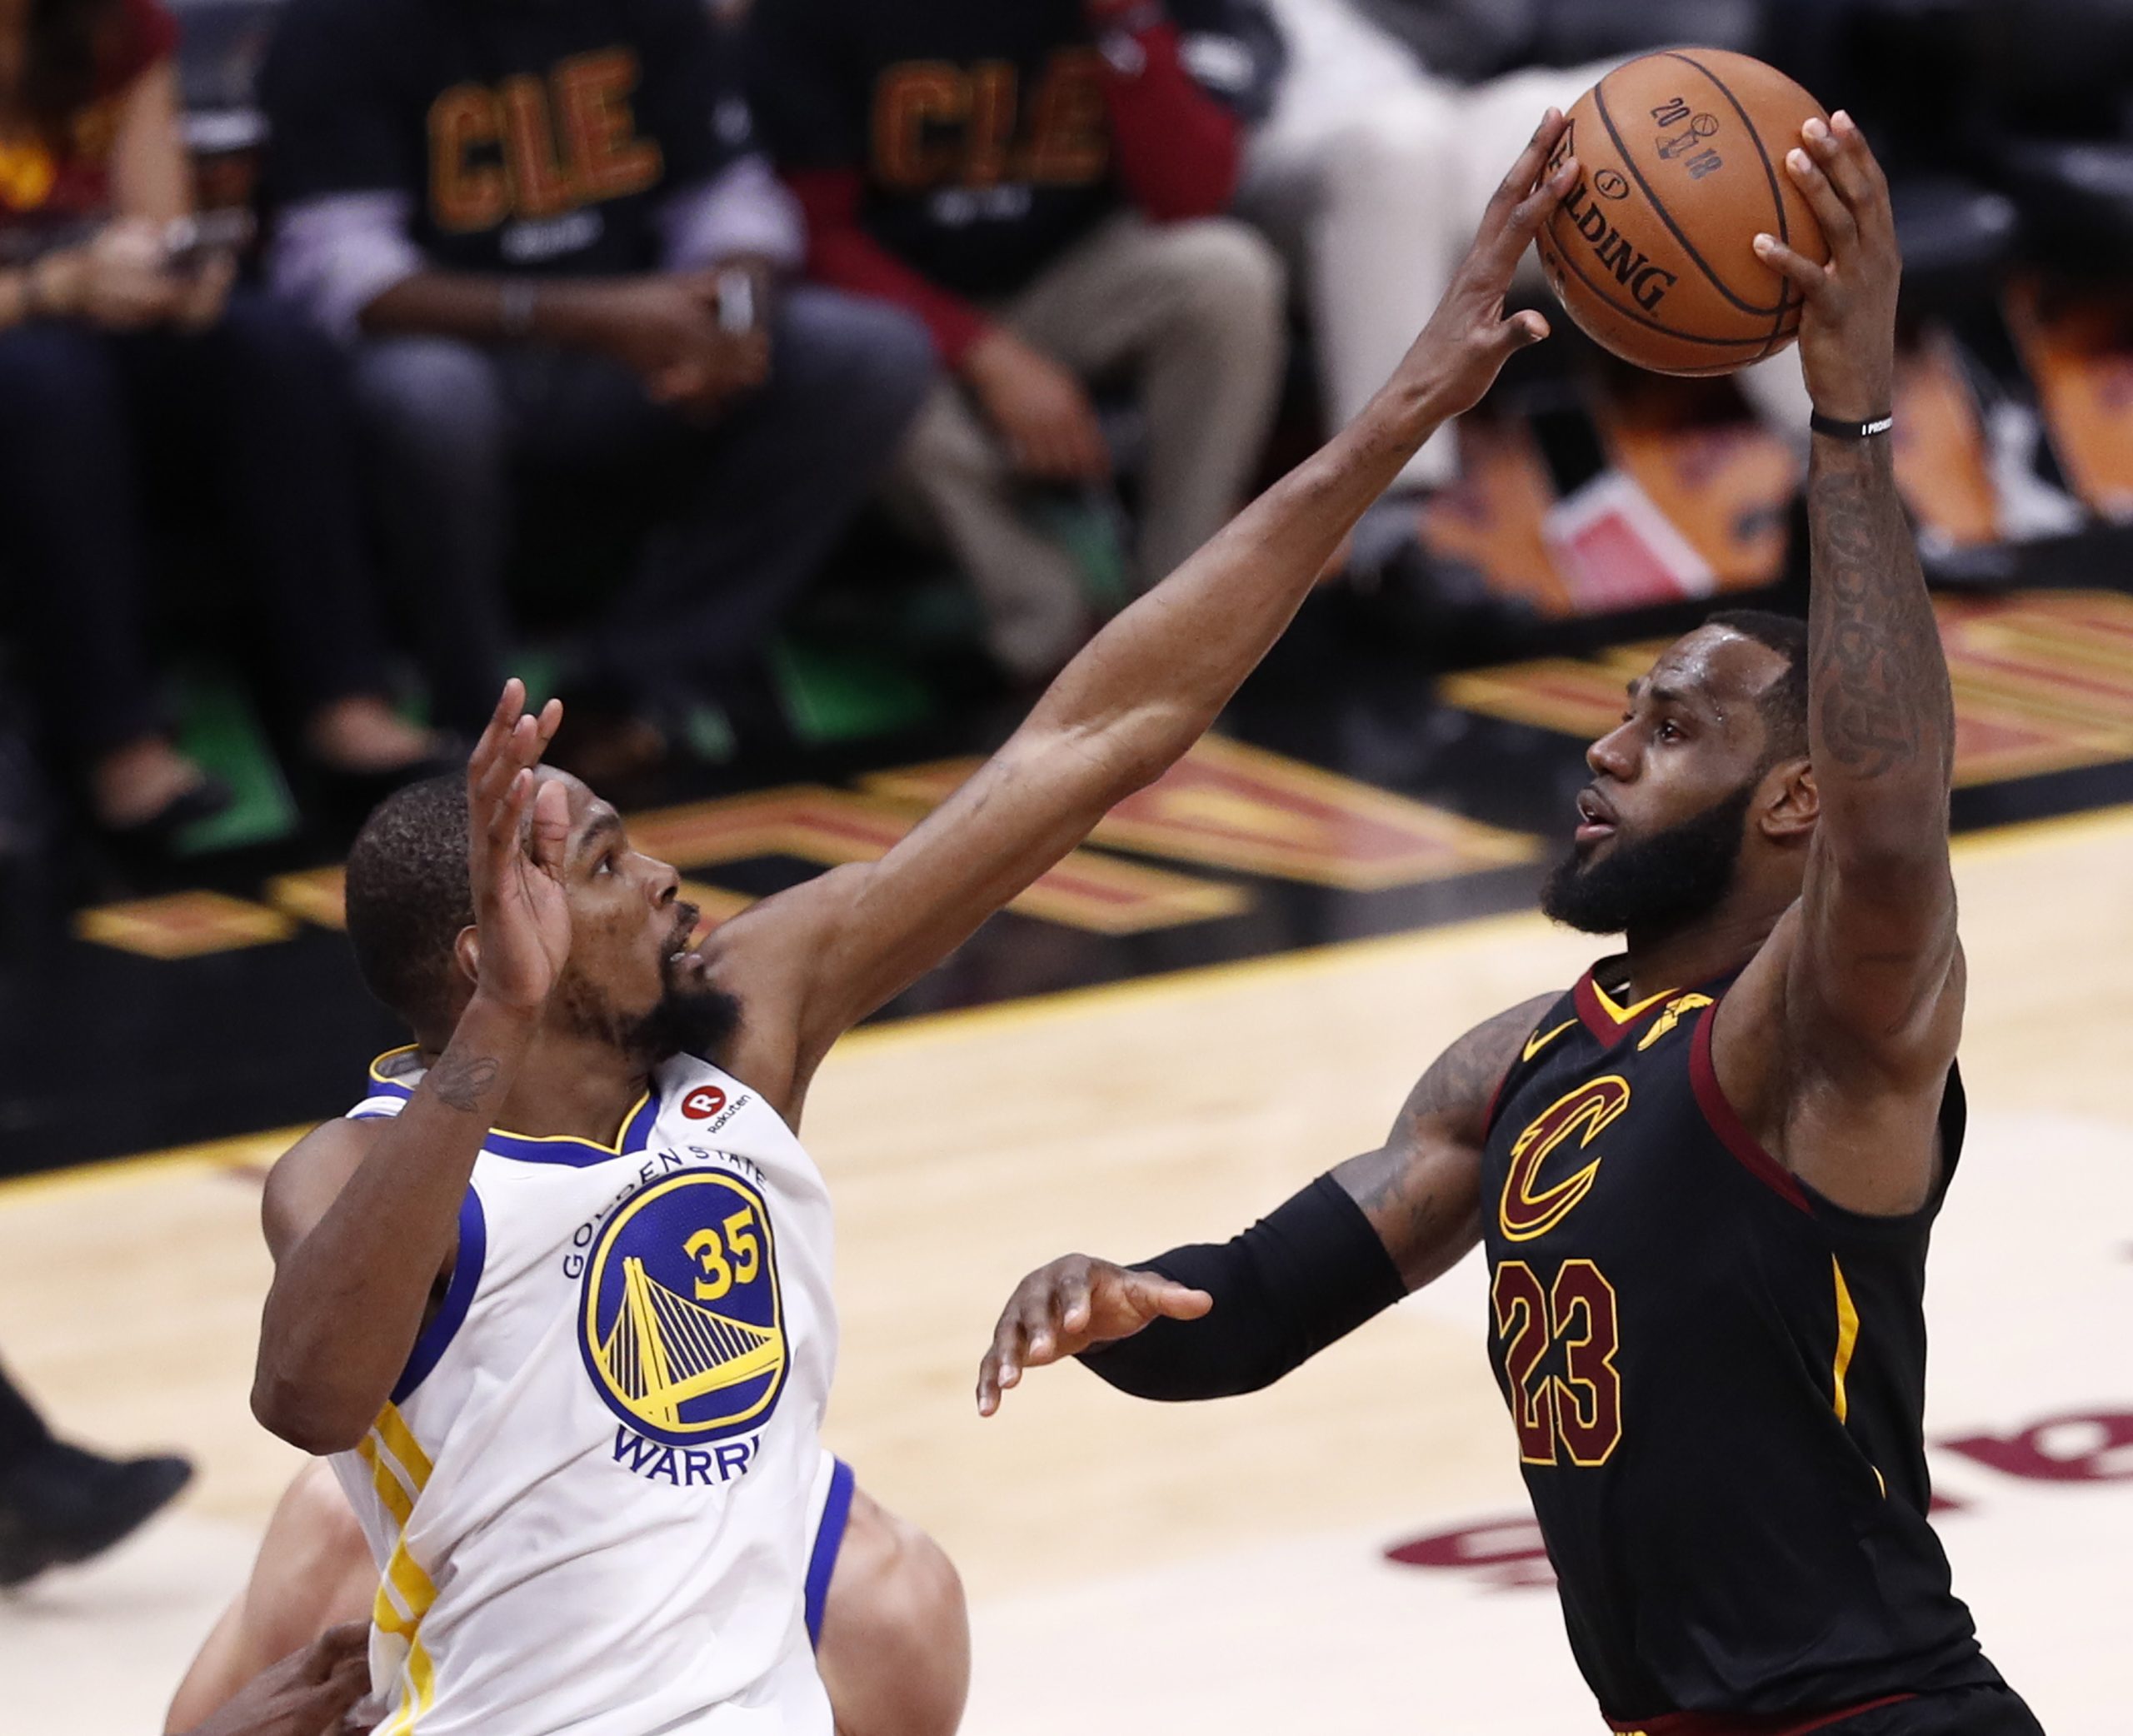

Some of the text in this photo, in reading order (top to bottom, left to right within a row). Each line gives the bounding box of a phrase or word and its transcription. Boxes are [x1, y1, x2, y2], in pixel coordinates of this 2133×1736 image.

[428, 50, 663, 231] CLE
[1651, 97, 1723, 180] 20 18
[1563, 182, 1678, 312] LDING
[707, 1094, 752, 1134] Rakuten
[1499, 1075, 1631, 1242] C
[563, 1145, 767, 1280] GOLDEN STATE
[682, 1205, 760, 1300] 35
[1492, 1259, 1623, 1467] 23
[612, 1424, 760, 1486] WARRI
